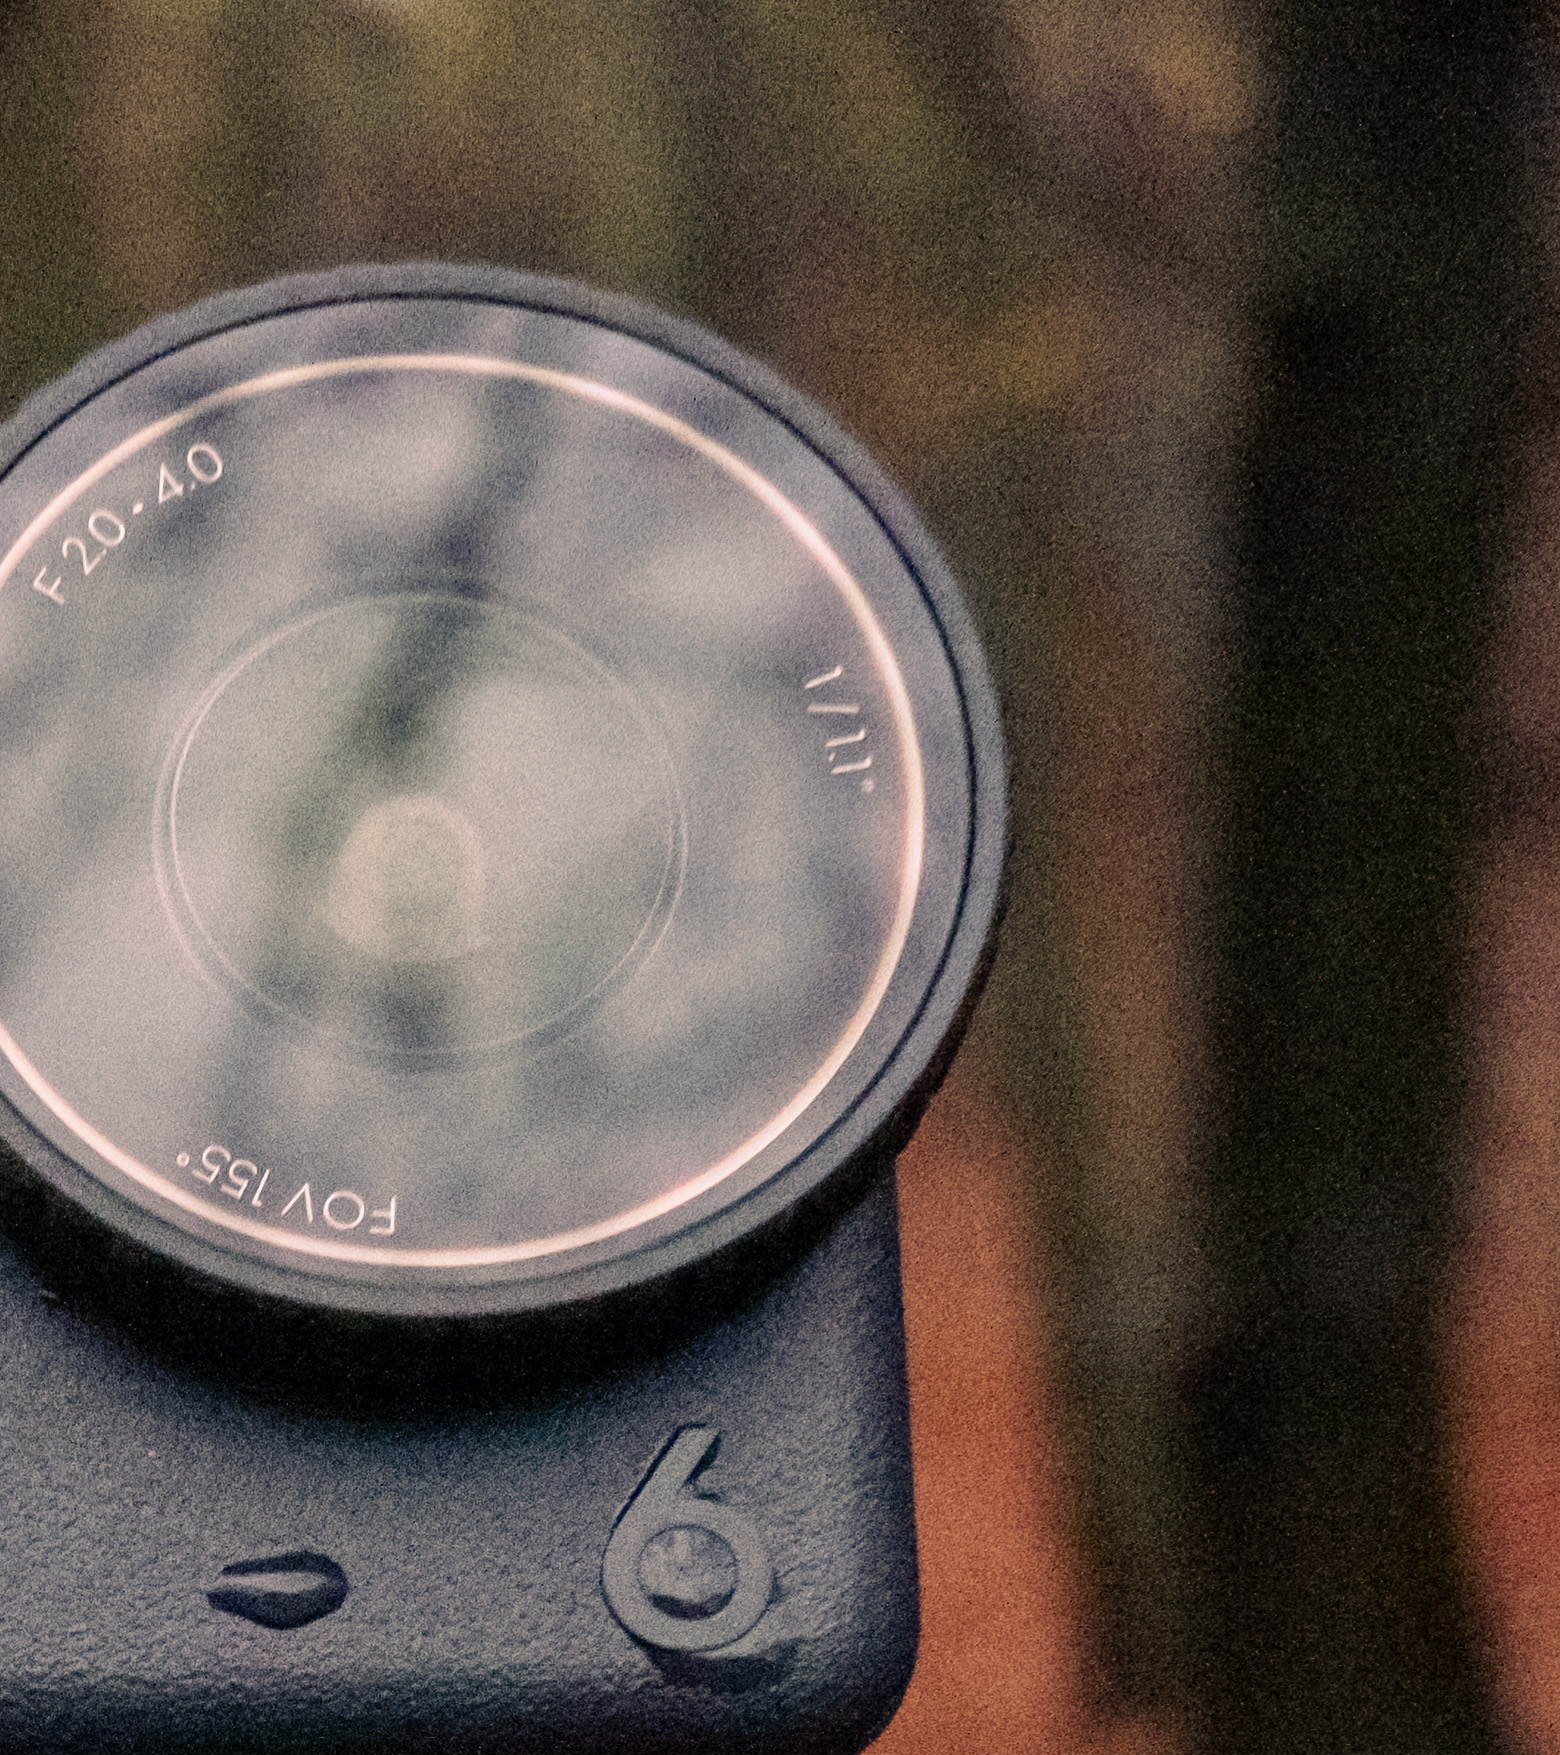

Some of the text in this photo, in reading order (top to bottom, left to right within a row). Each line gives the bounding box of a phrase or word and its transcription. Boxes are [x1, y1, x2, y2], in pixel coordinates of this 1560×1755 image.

[32, 566, 66, 606] F
[176, 1144, 398, 1237] FOV 155°
[600, 1422, 778, 1652] 6
